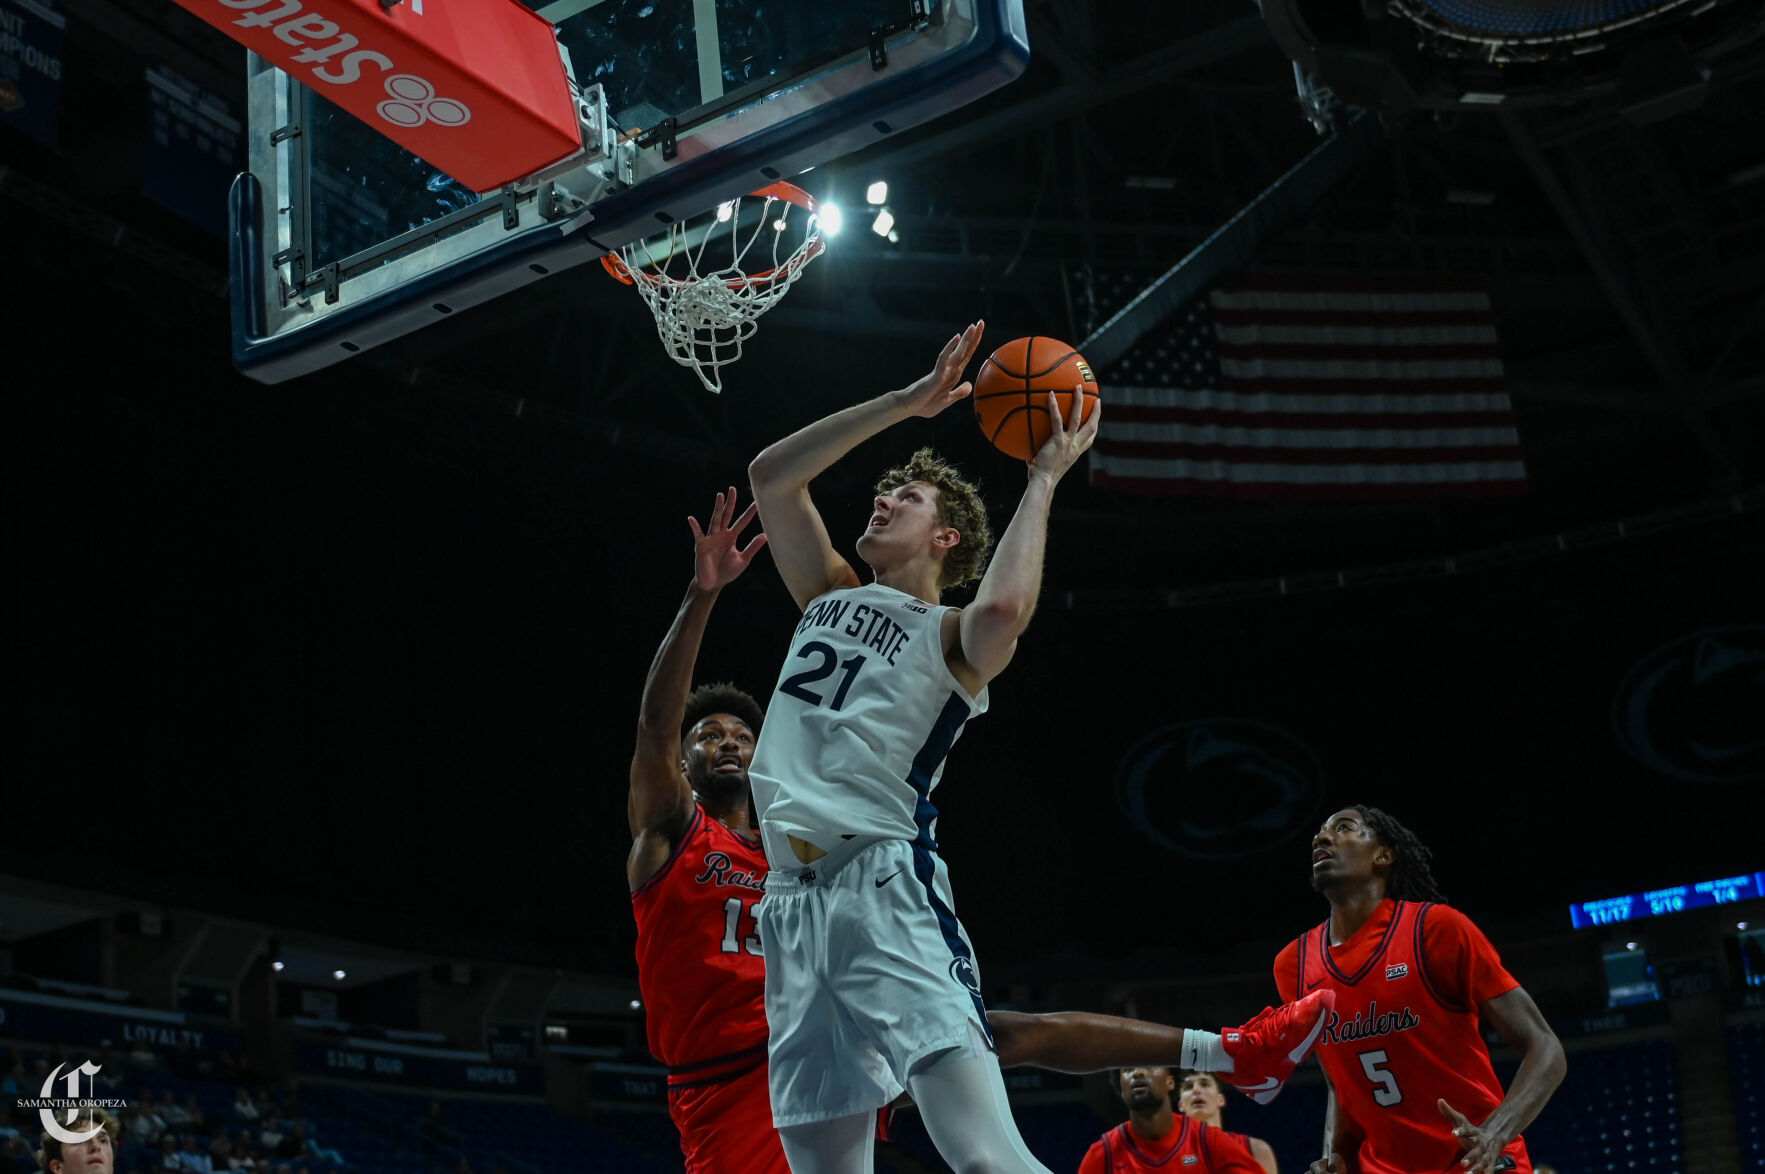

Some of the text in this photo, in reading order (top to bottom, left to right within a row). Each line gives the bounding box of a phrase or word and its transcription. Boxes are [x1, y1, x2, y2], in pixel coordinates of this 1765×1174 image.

[0, 32, 62, 80] MPIONS
[845, 604, 910, 667] STATE
[779, 641, 867, 711] 21
[695, 851, 768, 892] Raid
[799, 870, 817, 885] PSU
[123, 1022, 205, 1049] LOYALTY
[1322, 1000, 1421, 1045] Raiders
[1357, 1049, 1404, 1107] 5
